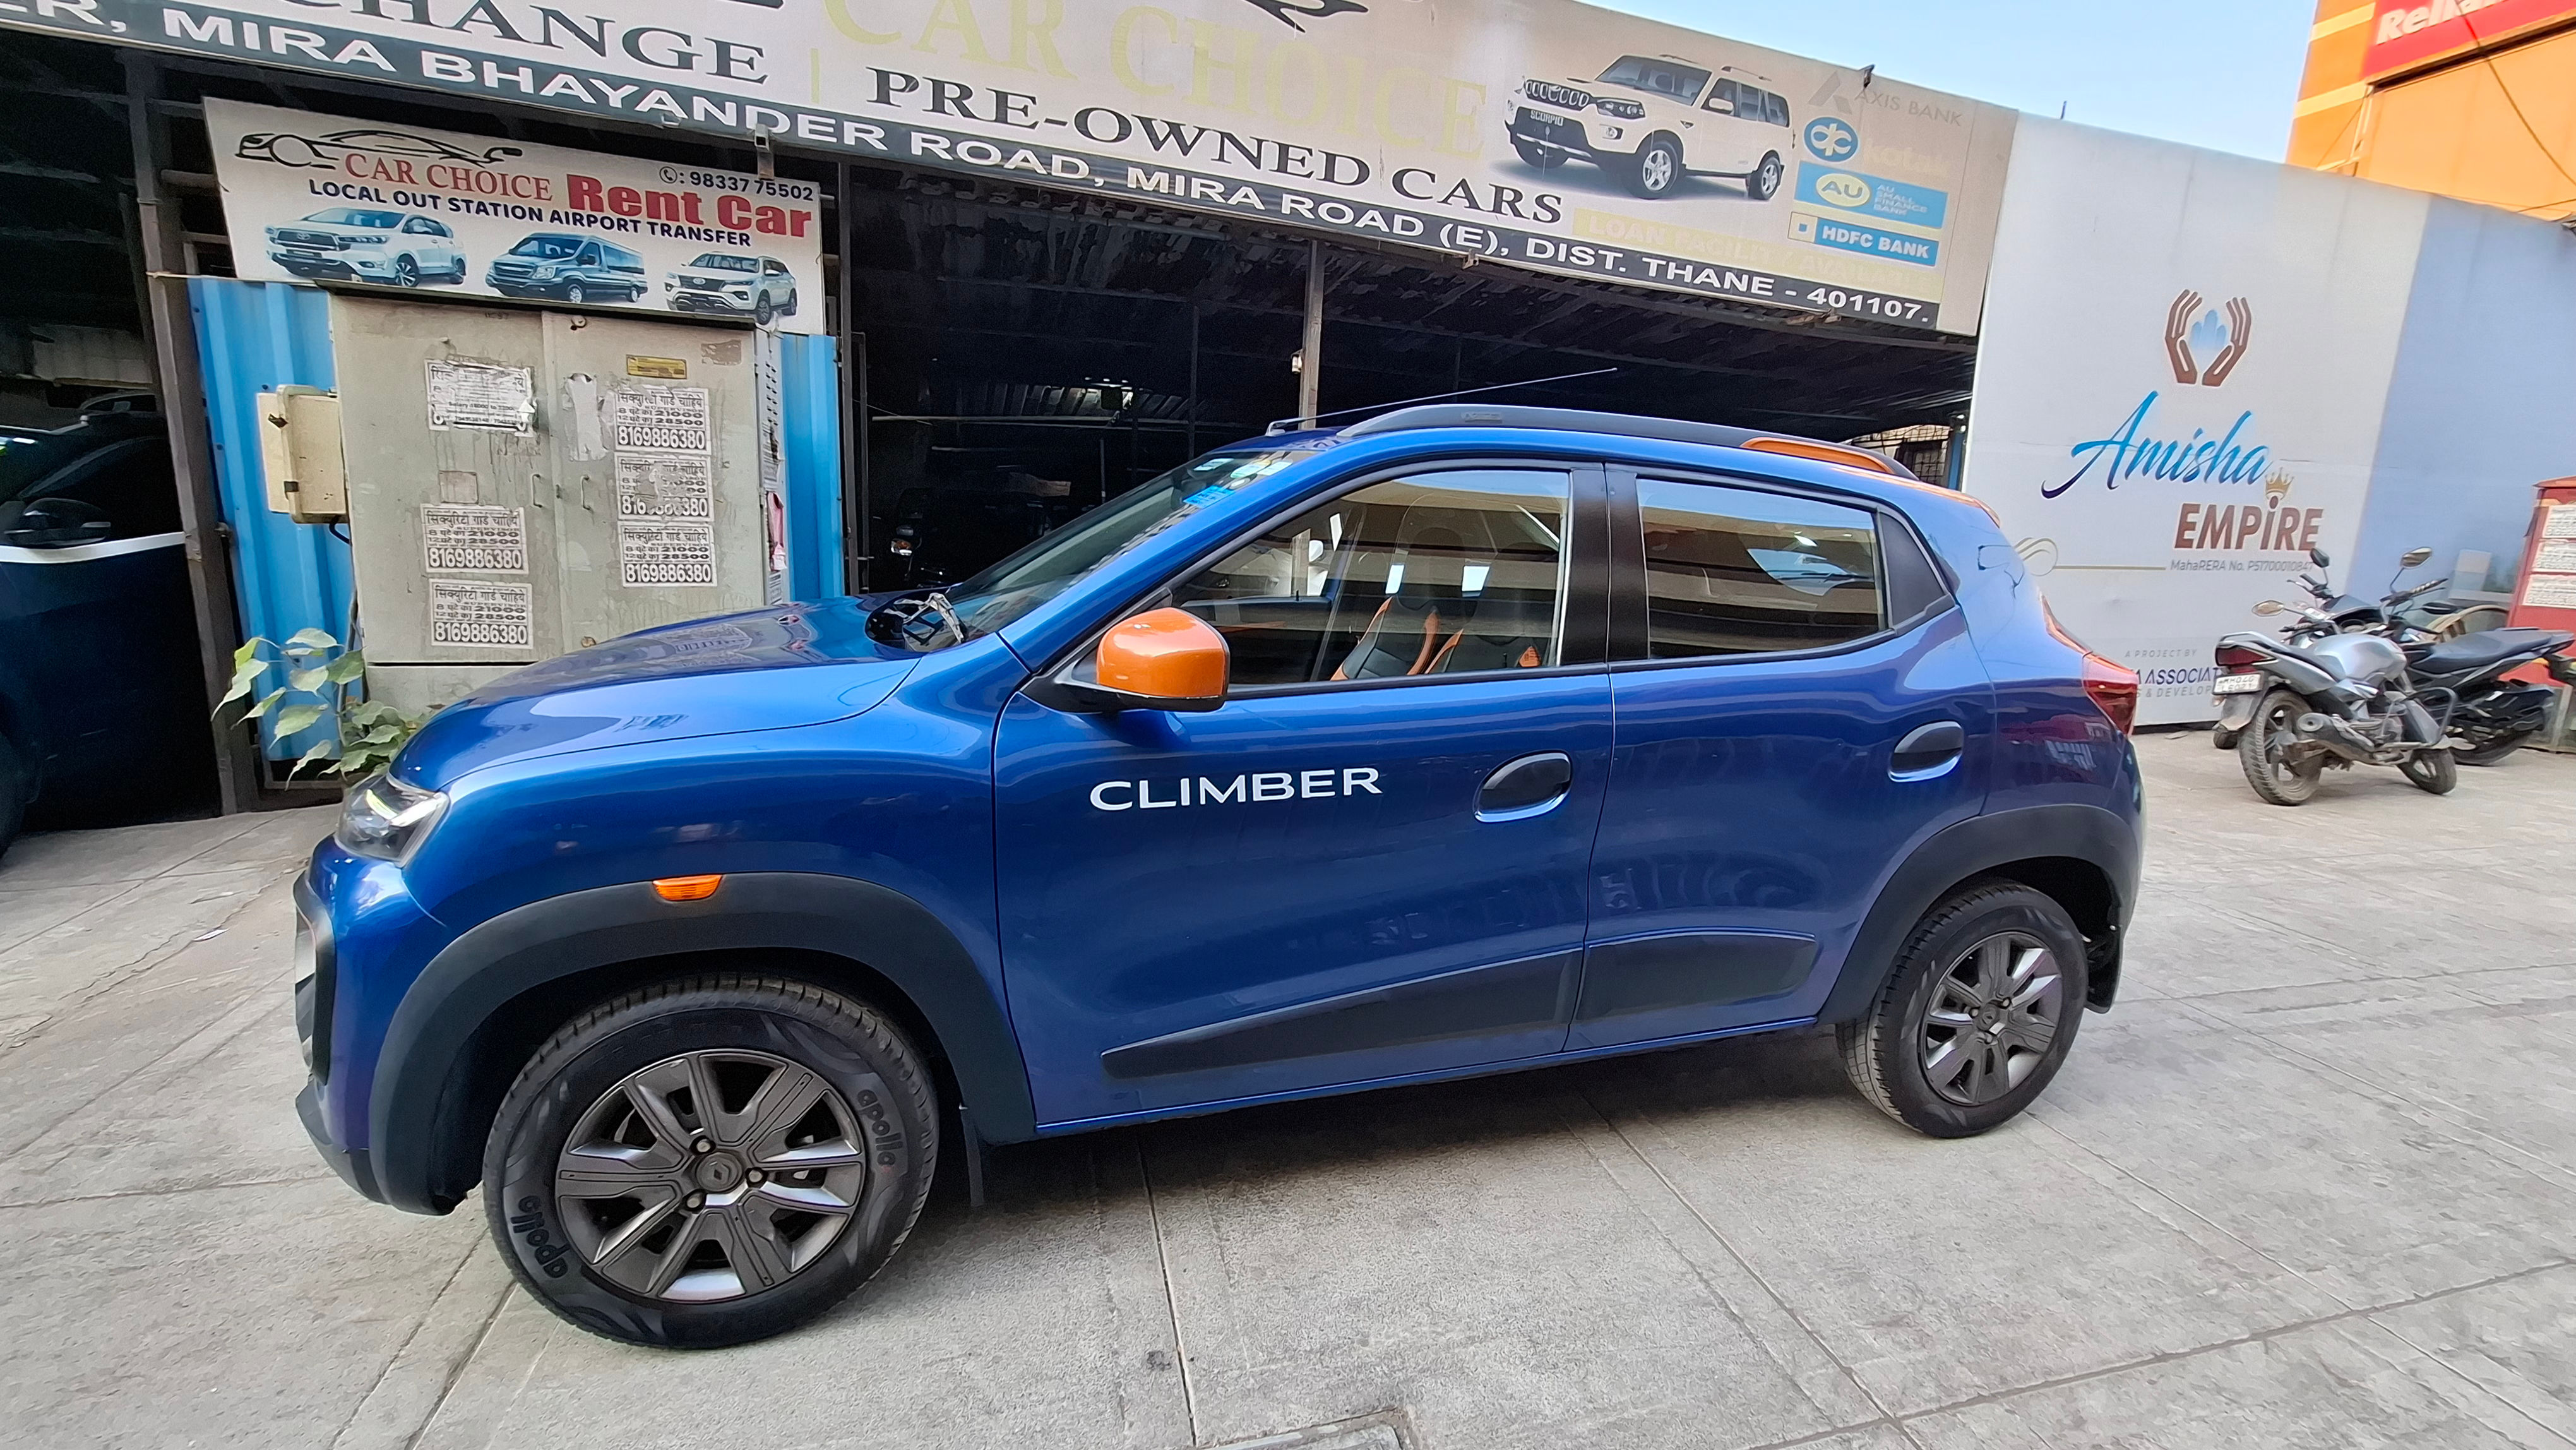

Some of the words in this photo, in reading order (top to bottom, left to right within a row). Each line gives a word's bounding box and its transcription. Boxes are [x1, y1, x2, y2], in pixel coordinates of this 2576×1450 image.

[1110, 5, 1487, 159] CHOICE
[1854, 88, 1900, 111] AXIS
[1909, 101, 1963, 126] BANK
[866, 66, 1370, 186] PRE-OWNED
[1392, 169, 1563, 223] CARS
[163, 8, 397, 72] MIRA
[420, 50, 887, 150] BHAYANDER
[910, 132, 1104, 186] ROAD,
[1127, 167, 1265, 210] MIRA
[1281, 193, 1425, 237] ROAD
[1440, 224, 1510, 256] (E),
[1526, 237, 1626, 272] DIST.
[1642, 256, 1775, 297] THANE
[1807, 288, 1929, 321] 401107.
[345, 153, 419, 186] CAR
[426, 164, 553, 201] CHOICE
[1822, 181, 1863, 198] AU
[1876, 191, 1914, 204] SMALL
[1878, 184, 1895, 193] AU
[309, 179, 387, 203] LOCAL
[393, 191, 441, 210] OUT
[448, 198, 543, 222] STATION
[549, 210, 641, 233] AIRPORT
[647, 222, 751, 247] TRANSFER
[566, 174, 704, 225] Rent
[717, 195, 811, 237] Car
[1873, 204, 1908, 215] BANK
[1875, 197, 1928, 213] FINANCE
[1589, 215, 1666, 245] LOAN
[1822, 225, 1873, 248] HDFC
[1878, 236, 1929, 259] BANK
[618, 426, 705, 449] 8169886380
[2041, 390, 2271, 499] Amisha
[429, 548, 522, 568] 8169886380
[626, 563, 711, 582] 8169886380
[435, 622, 527, 644] 8169886380
[2135, 649, 2181, 657] PROJECT
[2145, 667, 2219, 685] ASSOCIAT
[2157, 685, 2212, 698] DEVELOP
[1090, 767, 1383, 811] CLIMBER
[857, 1089, 905, 1167] apollo
[510, 1195, 569, 1279] apollo
